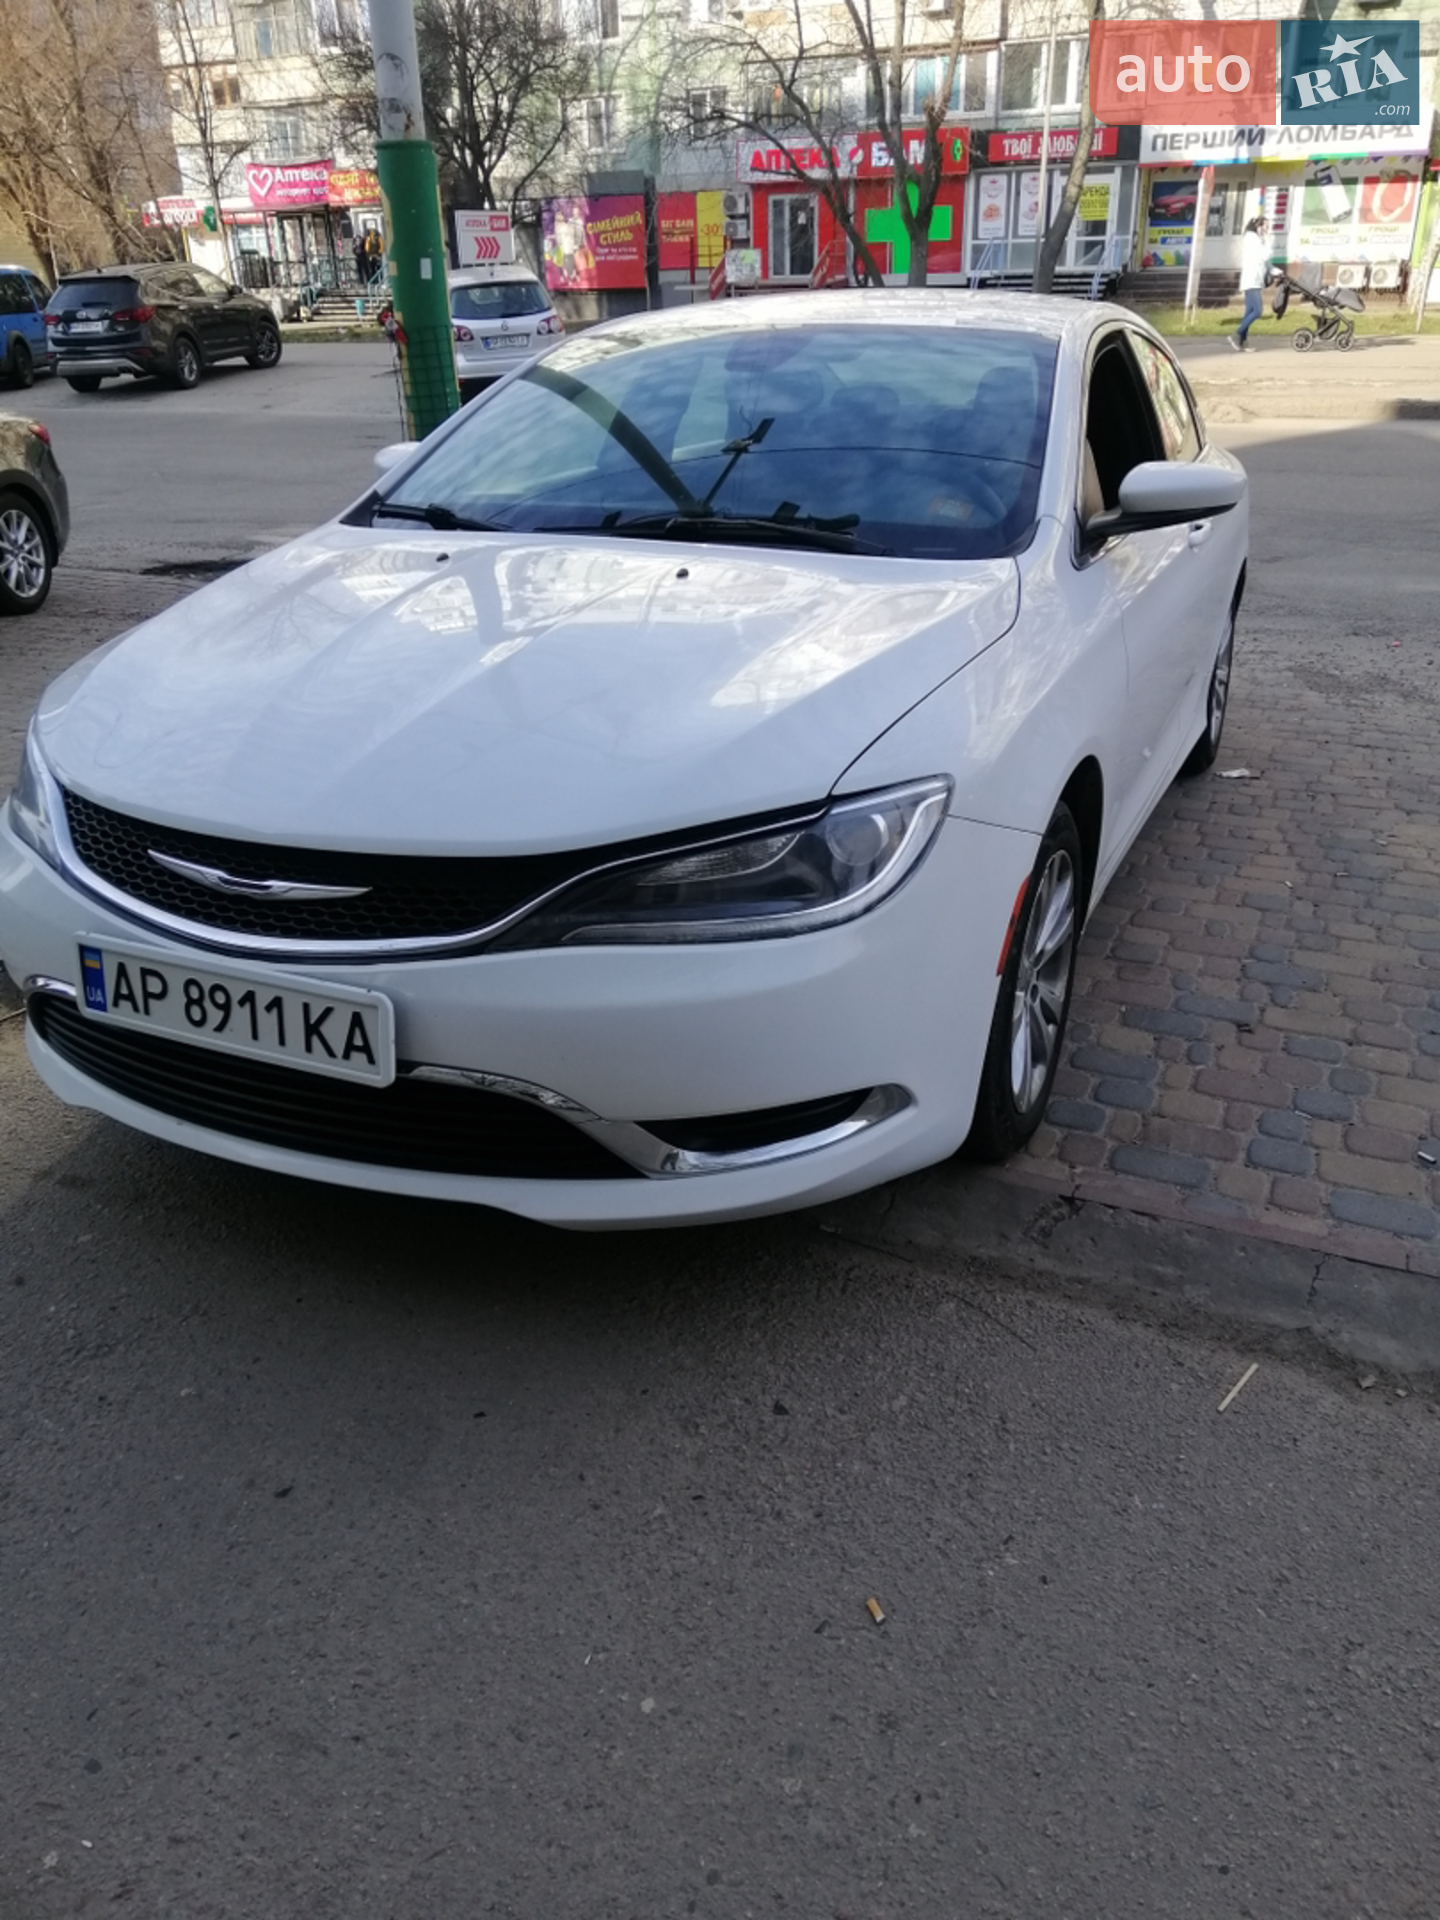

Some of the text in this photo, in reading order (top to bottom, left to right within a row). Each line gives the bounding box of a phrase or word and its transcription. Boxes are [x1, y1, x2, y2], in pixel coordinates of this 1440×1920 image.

[1002, 135, 1033, 156] ТВОЇ
[1151, 120, 1414, 151] ПЕРШИЙ ЛОМБАРД
[750, 145, 840, 171] АПТЕКА
[274, 167, 328, 182] Аптека
[600, 230, 633, 245] СТИЛЬ
[86, 986, 105, 1004] UA
[111, 961, 376, 1066] AP 8911 KA
